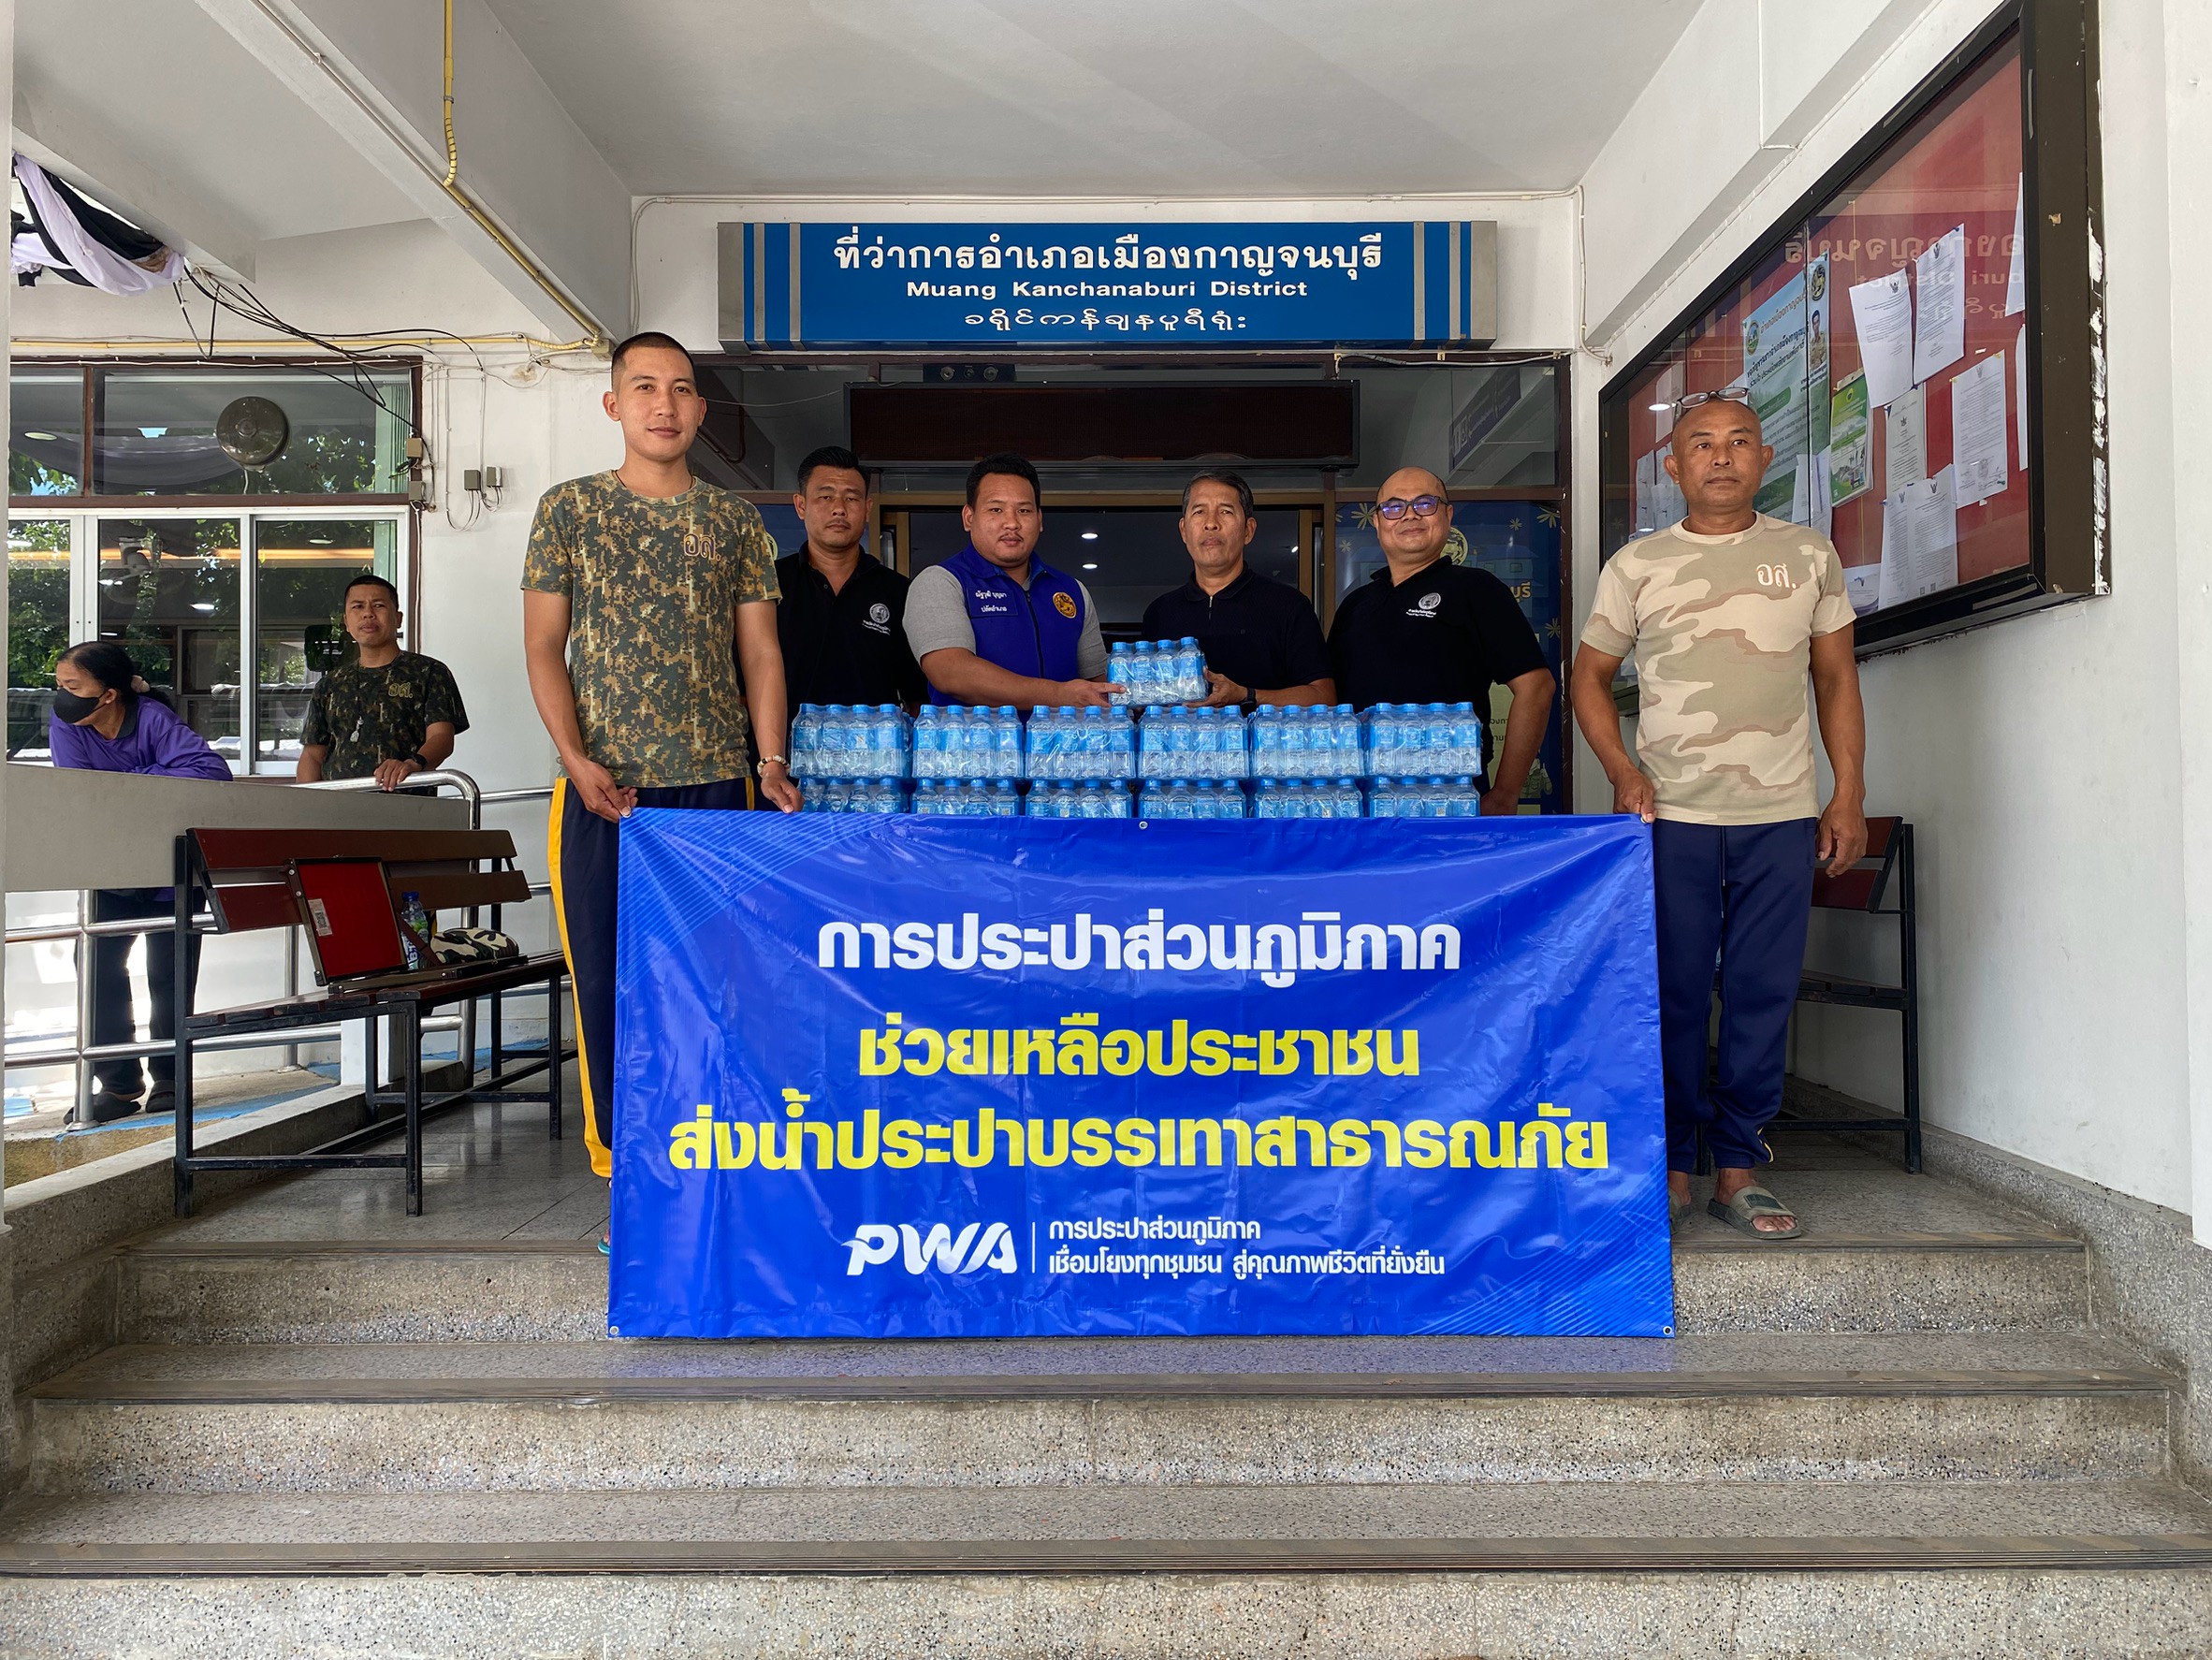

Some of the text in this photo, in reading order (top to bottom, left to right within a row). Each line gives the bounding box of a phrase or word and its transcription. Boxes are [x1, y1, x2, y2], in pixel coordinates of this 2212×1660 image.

[833, 226, 1383, 280] ที่ว่าการอำเภอเมืองกาญจนบุรี
[907, 281, 1308, 300] Muang Kanchanaburi District
[683, 533, 720, 561] อส.
[1755, 563, 1797, 590] อส.
[819, 908, 1461, 988] การประปาส่วนภูมิภาค
[859, 1012, 1419, 1076] ช่วยเหลือประชาชน
[669, 1088, 1608, 1170] ส่งน้ำประปาบรรเทาสาธารณภัย
[841, 1222, 1018, 1275] PWA
[1049, 1215, 1261, 1245] การประปาส่วนภูมิภาค
[1049, 1246, 1446, 1280] เชื่อมโยงทุกชุมชน สู่คุณภาพชีวิตที่ยั่งยืน
